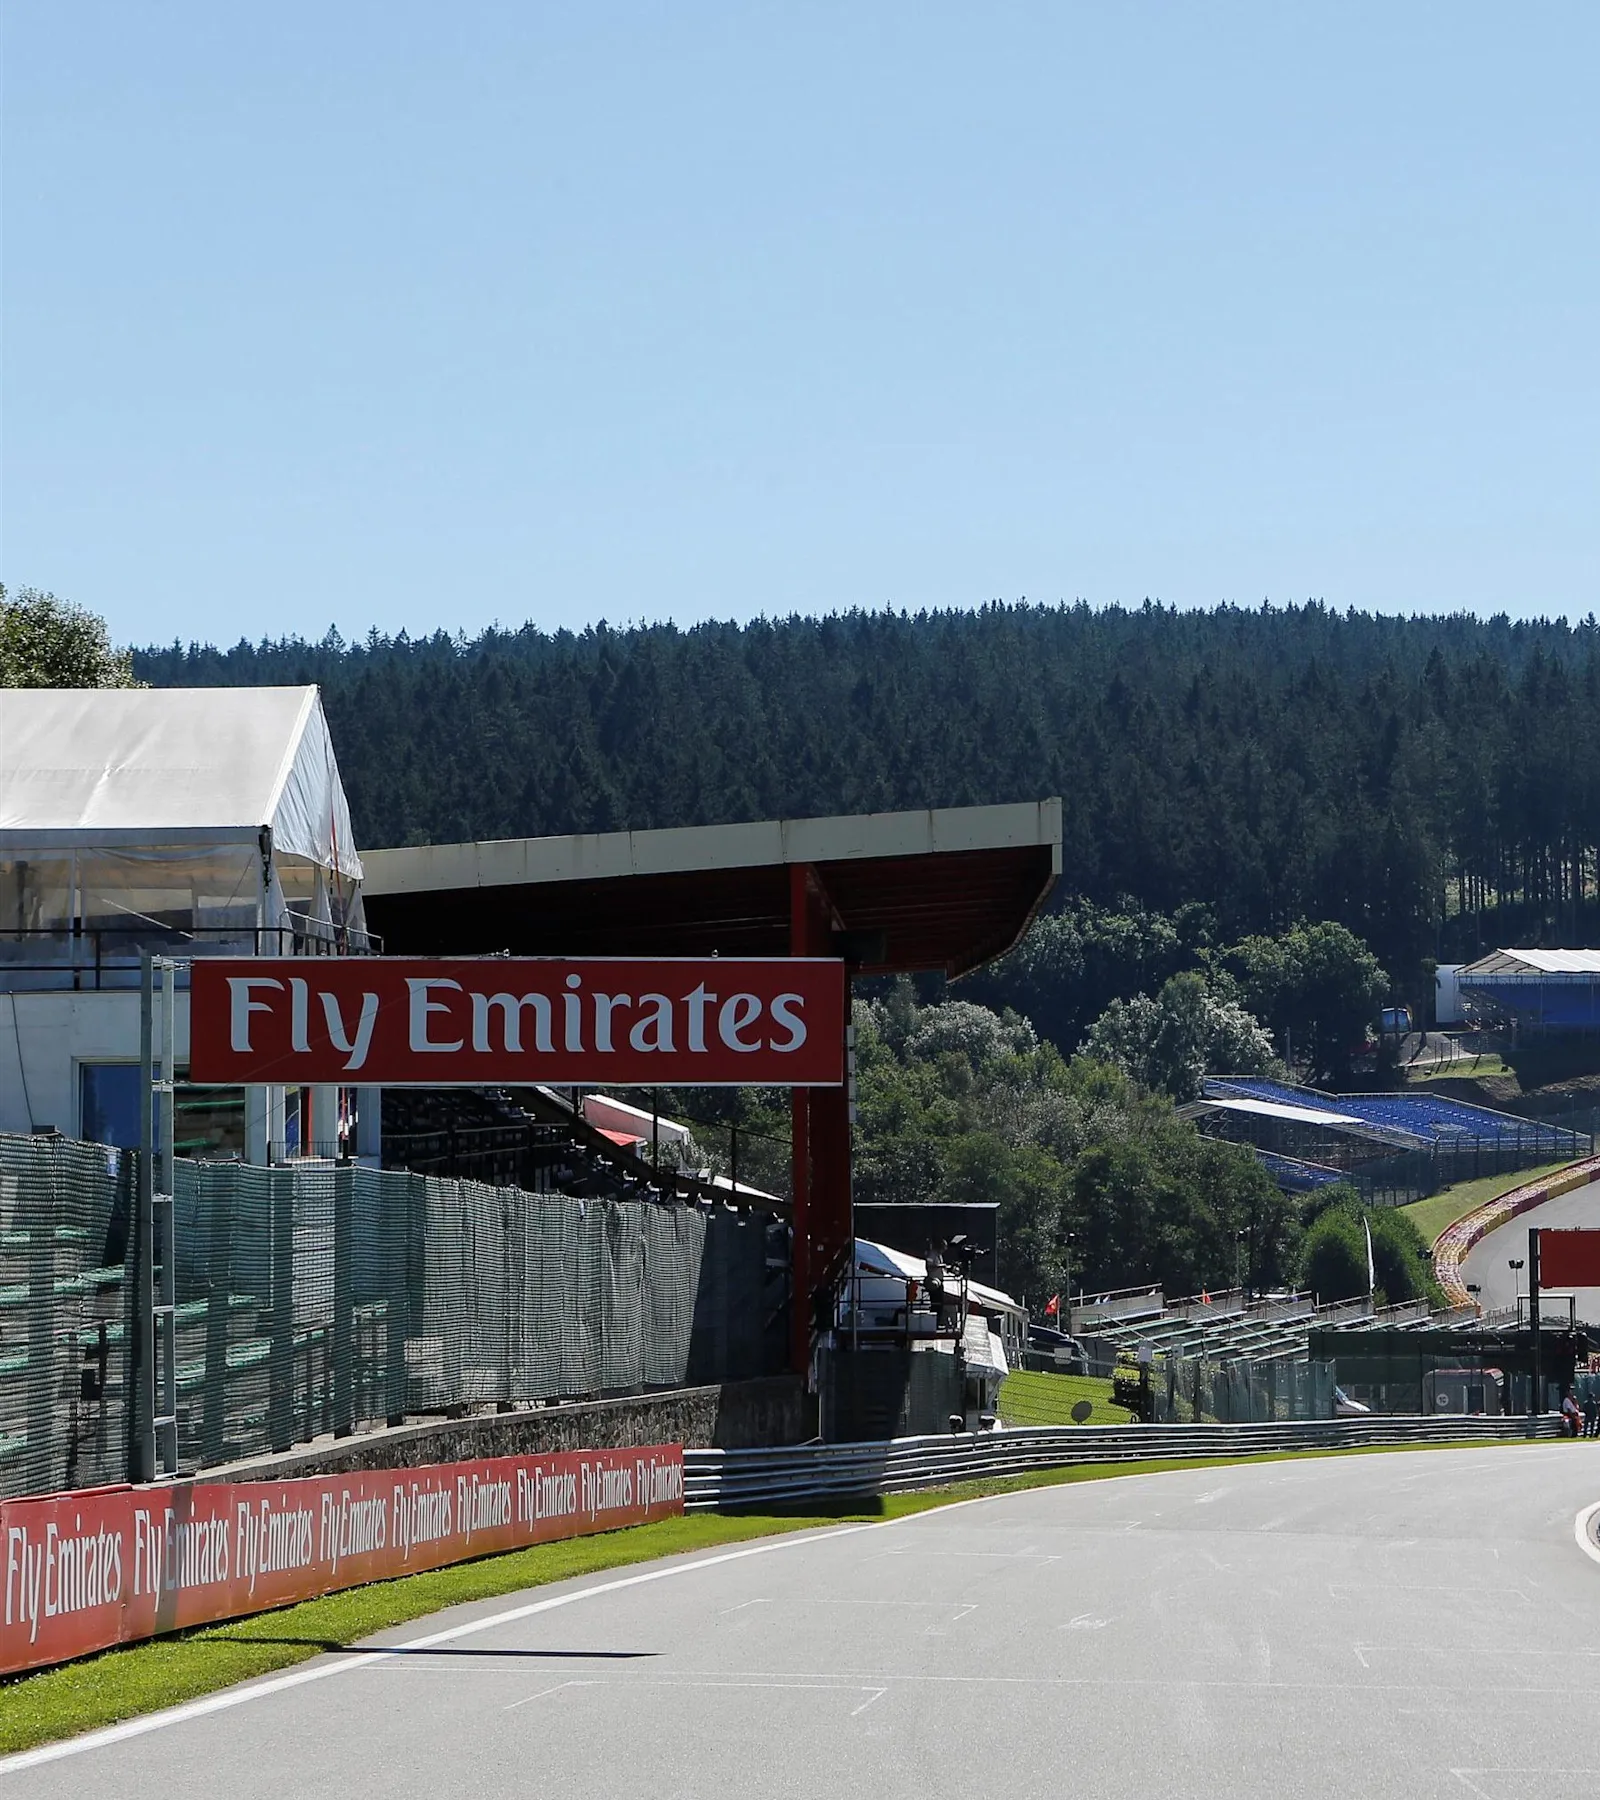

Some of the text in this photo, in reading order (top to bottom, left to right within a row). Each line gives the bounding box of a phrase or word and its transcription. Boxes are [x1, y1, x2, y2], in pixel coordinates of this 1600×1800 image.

[226, 974, 808, 1071] Fly Emirates
[392, 1477, 452, 1561] Fly Emirates
[457, 1469, 512, 1545] Fly Emirates
[516, 1463, 577, 1533] Fly Emirates
[580, 1458, 632, 1523] Fly Emirates
[636, 1454, 683, 1515] Fly Emirates
[134, 1501, 230, 1613] Fly Emirates
[235, 1493, 313, 1596] Fly Emirates
[320, 1484, 387, 1576] Fly Emirates
[6, 1513, 122, 1644] Fly Emirates
